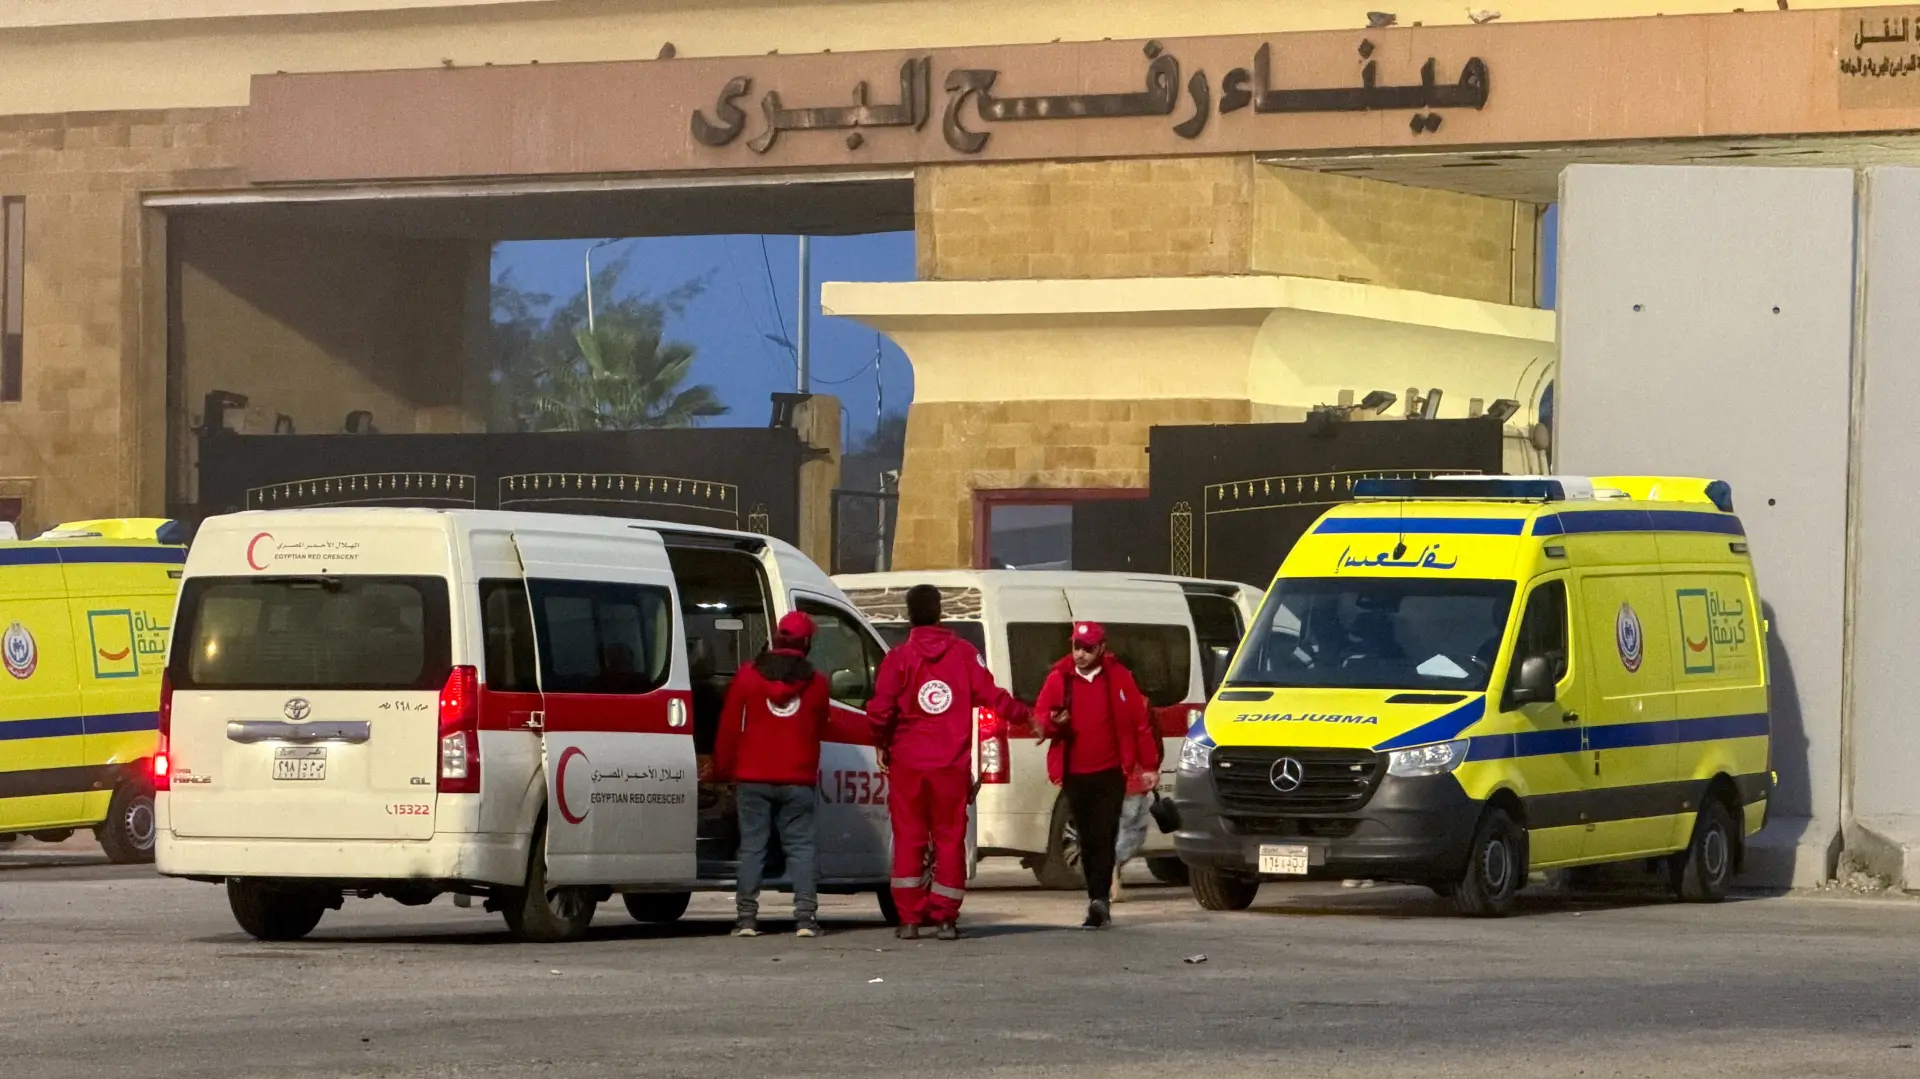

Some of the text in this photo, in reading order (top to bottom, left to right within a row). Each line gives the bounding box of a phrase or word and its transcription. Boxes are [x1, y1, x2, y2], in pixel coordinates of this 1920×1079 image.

[943, 39, 1210, 154] رفح
[1219, 38, 1490, 136] ميناء
[1710, 591, 1743, 619] حياة
[1713, 619, 1746, 652] كريمة
[410, 776, 431, 786] GL
[625, 766, 658, 782] الأحمر
[659, 767, 685, 782] الهلال
[590, 792, 685, 804] EGYPTIAN RED CRESCENT
[834, 770, 889, 805] 1532
[393, 804, 430, 815] 15322
